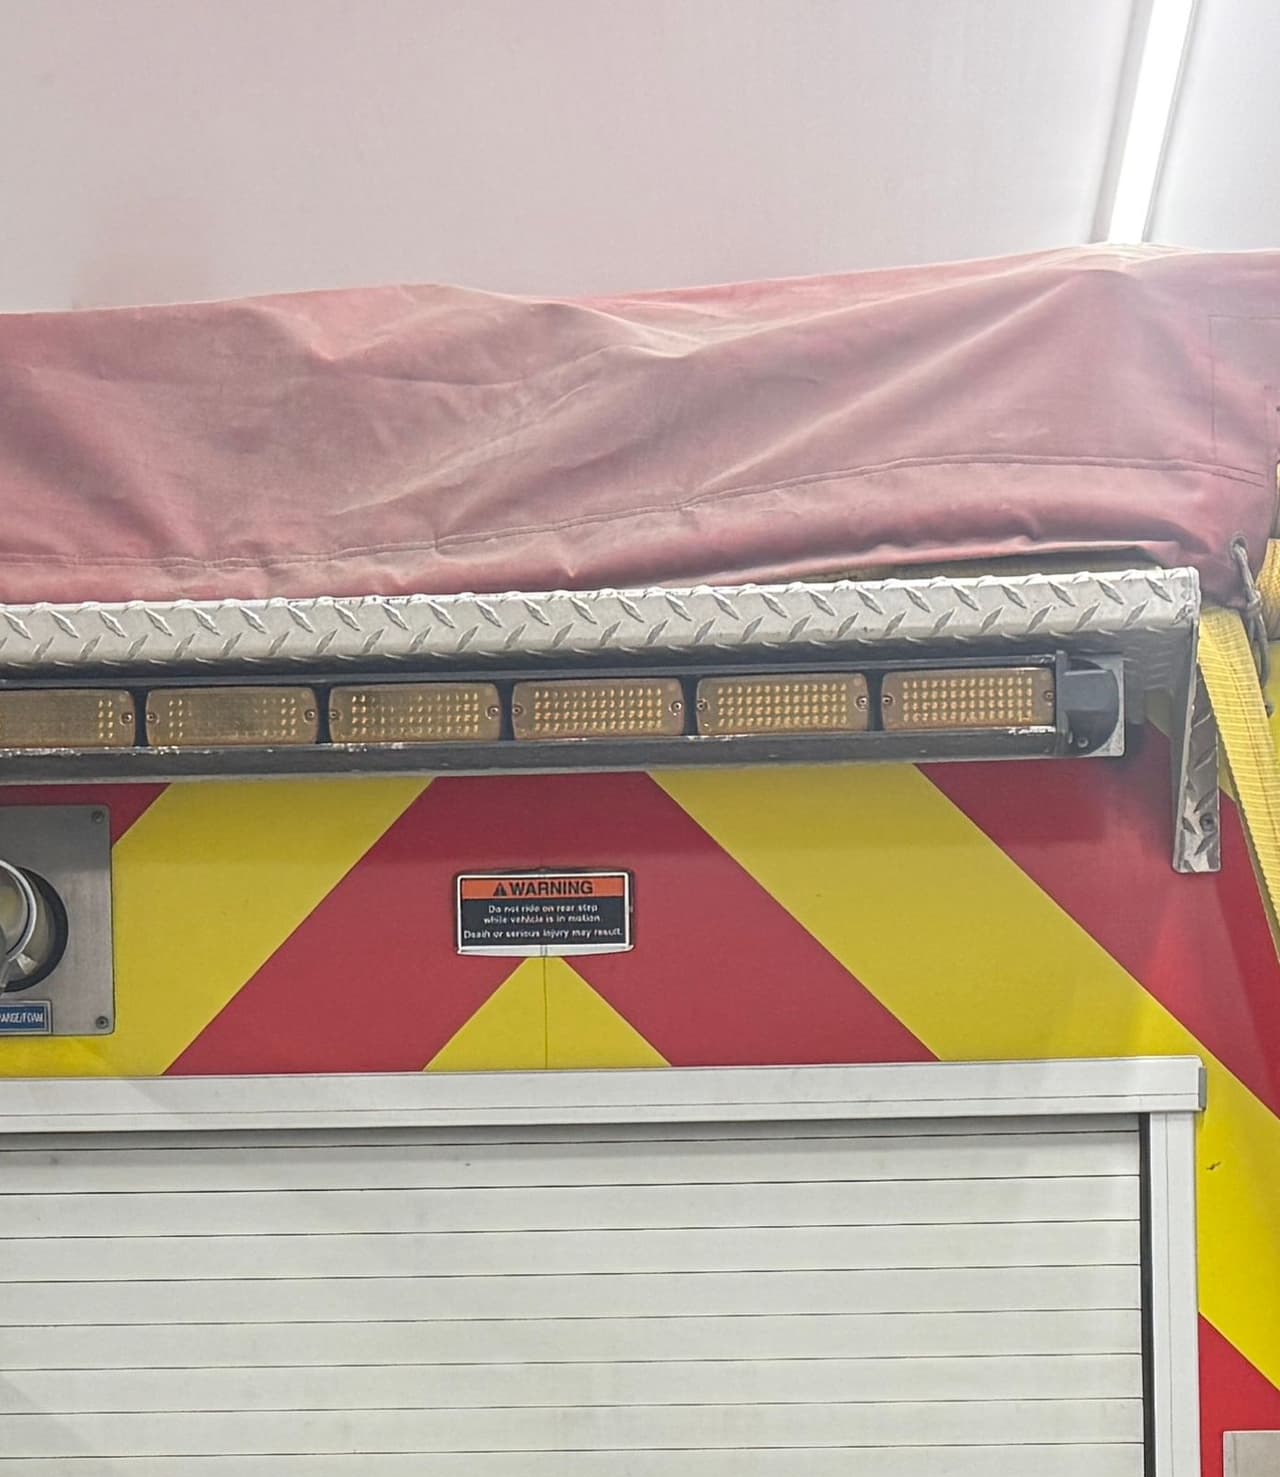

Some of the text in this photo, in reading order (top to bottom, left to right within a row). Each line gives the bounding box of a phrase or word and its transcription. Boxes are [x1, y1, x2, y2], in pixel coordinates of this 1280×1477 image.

[508, 880, 593, 897] WARNING
[488, 903, 598, 914] Do not ride on rear step
[483, 915, 508, 924] while
[510, 914, 544, 924] vehicle
[546, 915, 554, 923] is
[556, 914, 566, 923] in
[463, 929, 491, 939] Death
[493, 930, 503, 939] or
[506, 930, 540, 938] serious
[542, 928, 570, 939] injury
[571, 929, 592, 939] may
